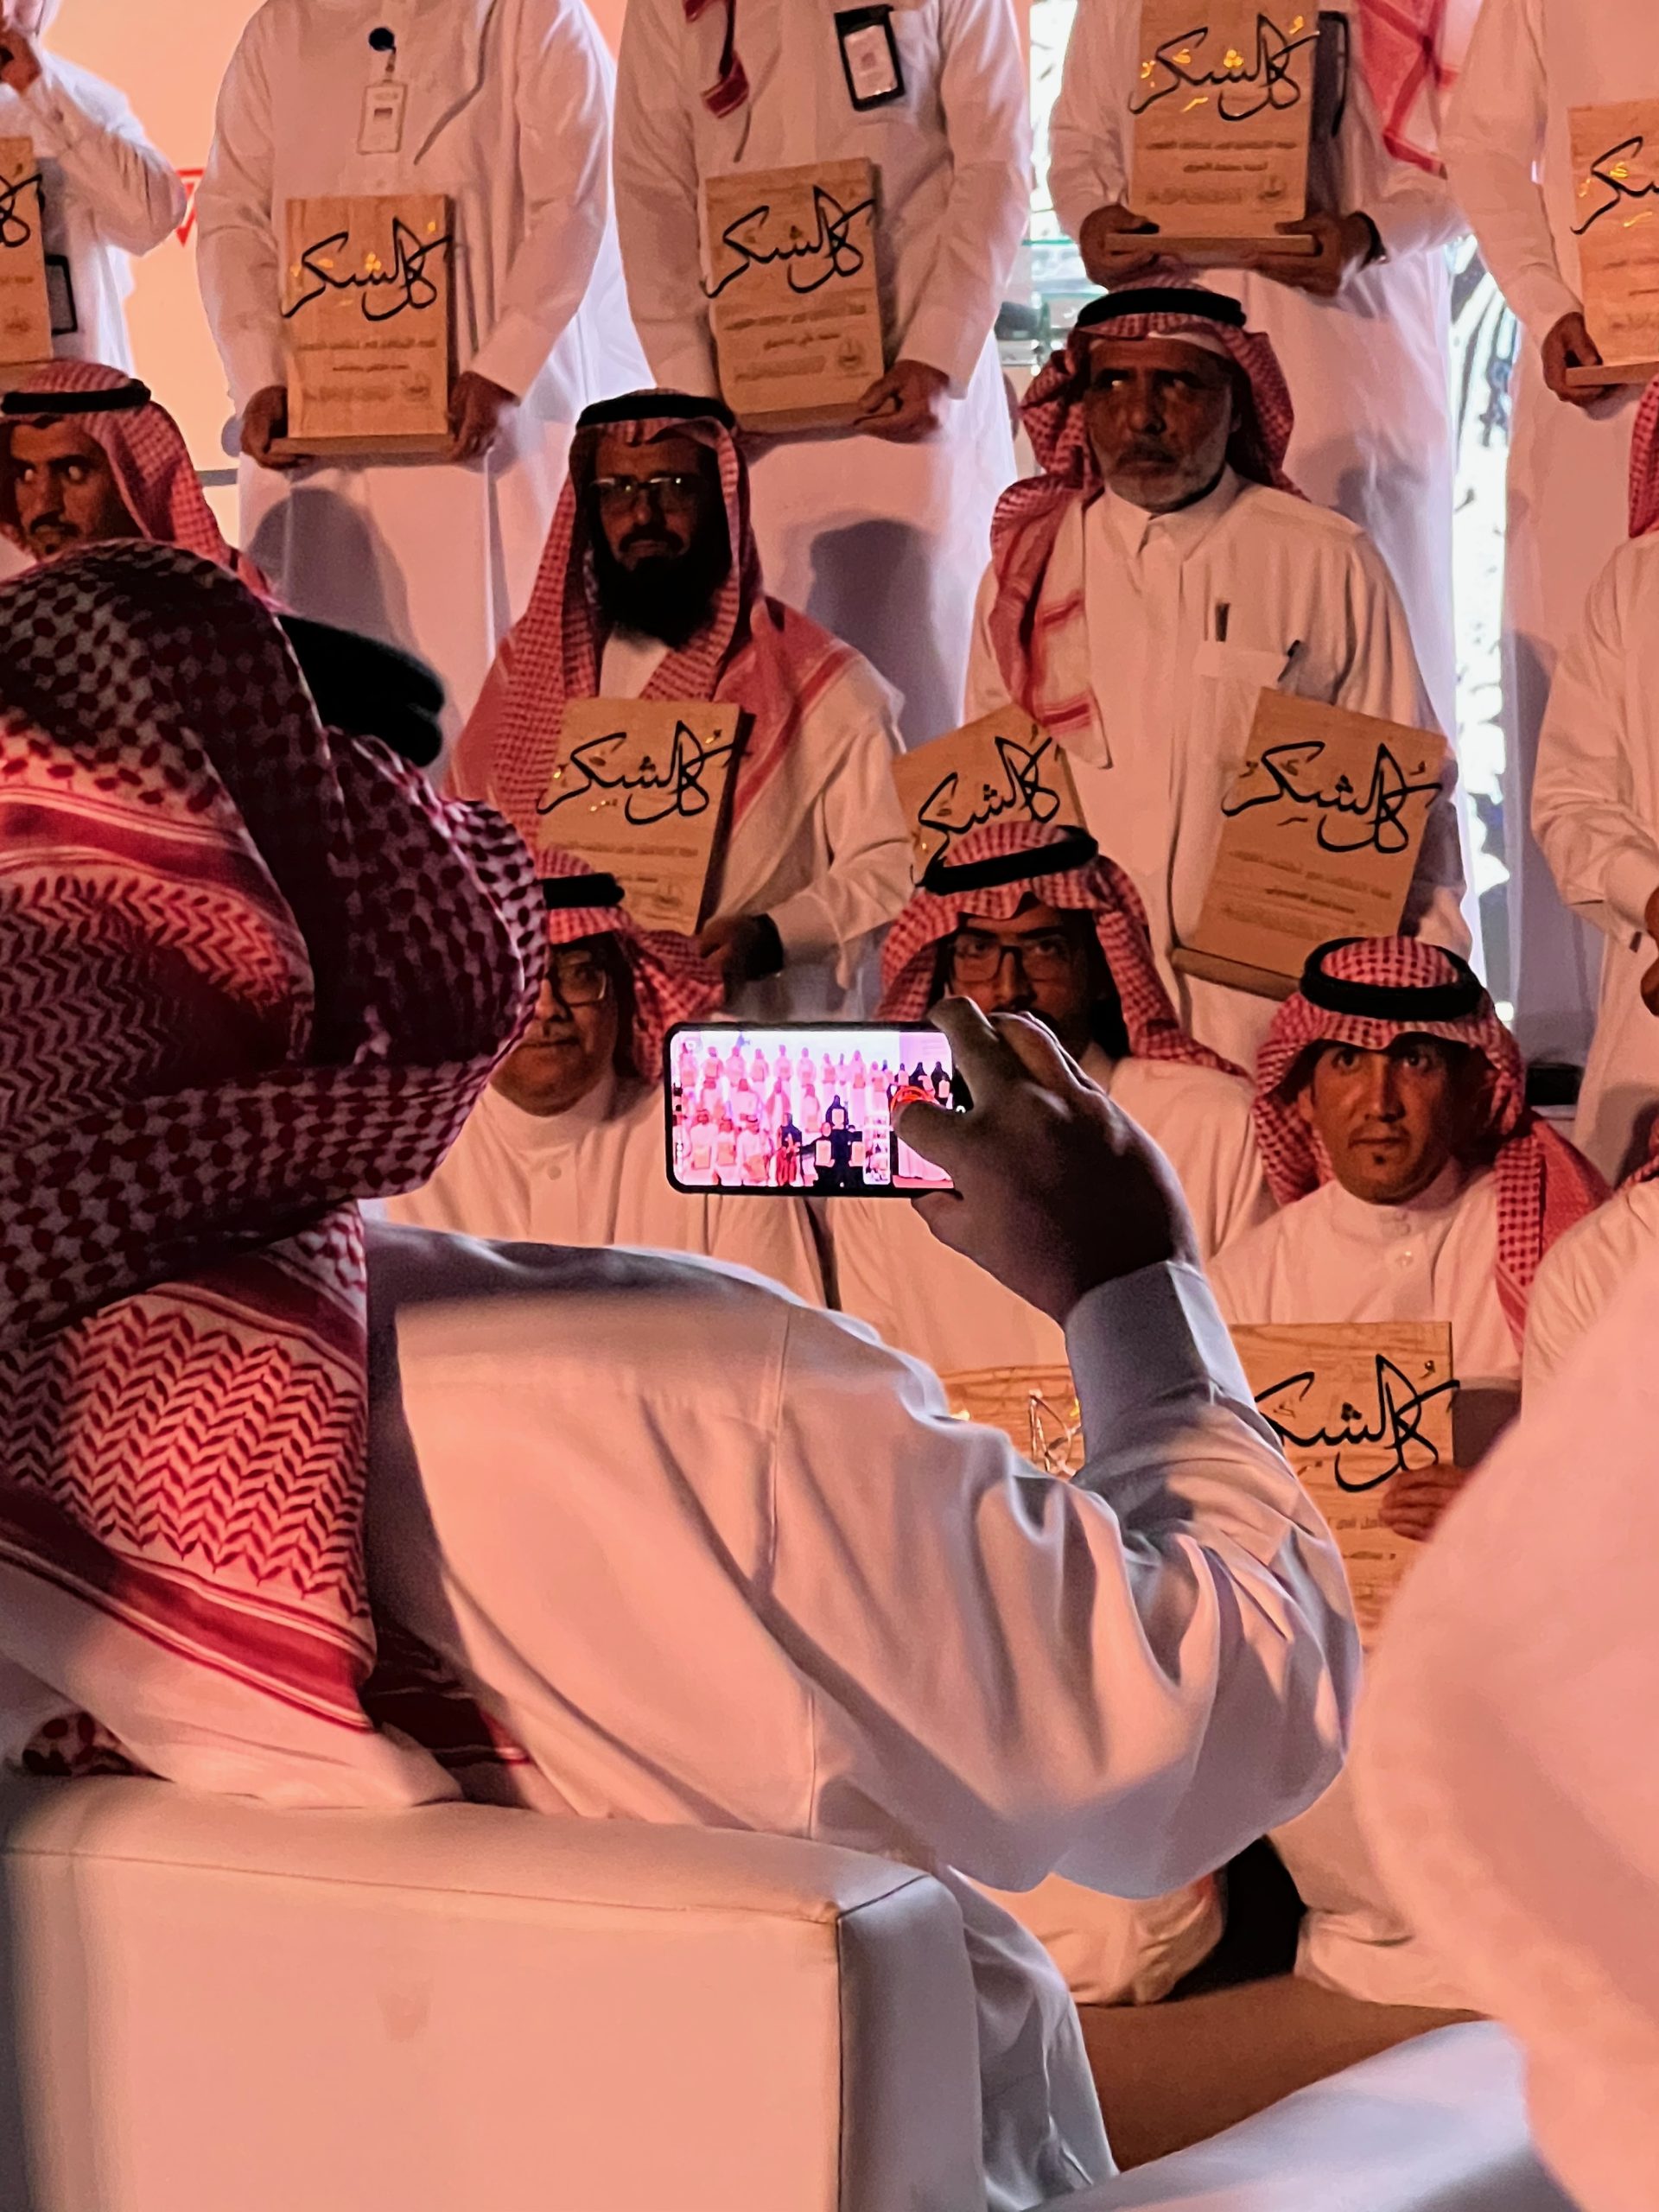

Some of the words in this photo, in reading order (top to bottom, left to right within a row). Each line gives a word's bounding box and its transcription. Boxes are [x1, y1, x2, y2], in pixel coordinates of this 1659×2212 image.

[1217, 31, 1320, 121] كل
[360, 234, 452, 321] كل
[786, 198, 876, 293] كل
[624, 741, 737, 825] كل
[1316, 769, 1443, 854] كل
